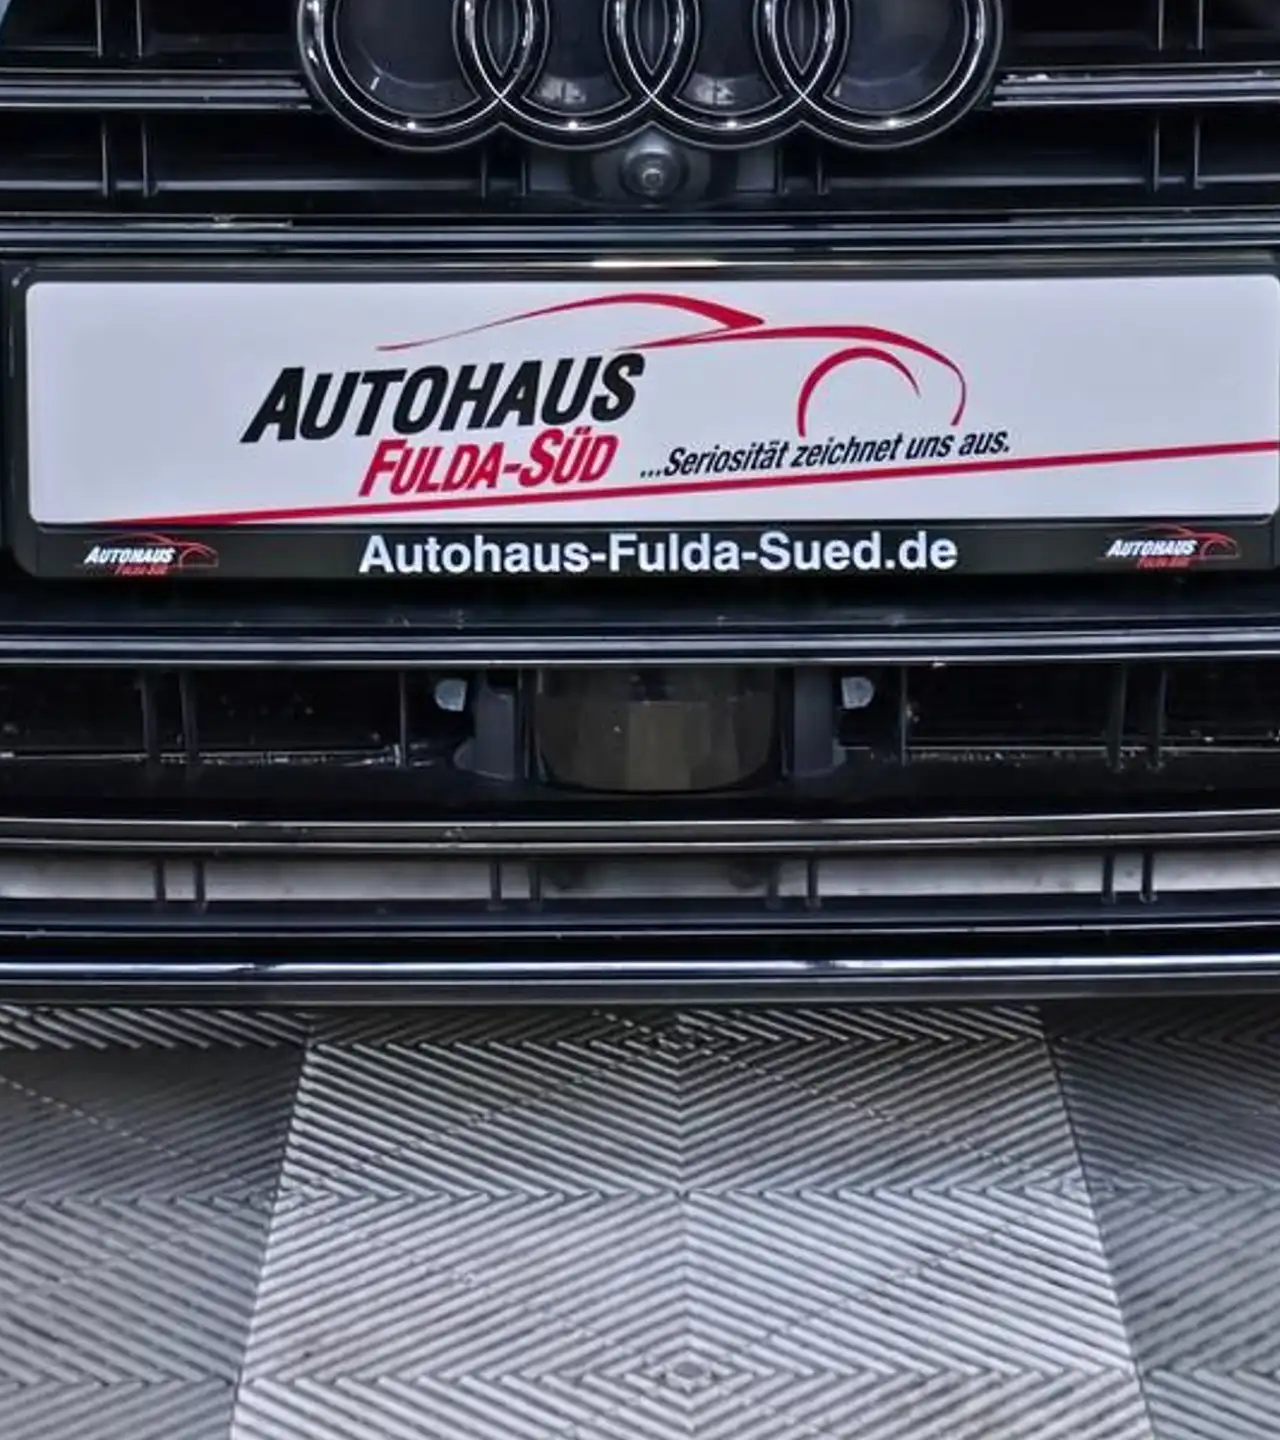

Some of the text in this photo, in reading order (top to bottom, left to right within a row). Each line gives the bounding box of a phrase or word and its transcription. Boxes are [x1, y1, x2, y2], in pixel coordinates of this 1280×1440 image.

[239, 352, 646, 444] AUTOHAUS
[358, 425, 620, 497] FULDA-SÜD
[790, 433, 901, 468] zeichnet
[905, 433, 952, 459] uns
[958, 429, 1011, 456] aus.
[83, 545, 177, 565] AUTOHAUS
[358, 530, 959, 573] Autohaus-Fulda-Sued.de
[1105, 540, 1199, 558] AUTOHAUS
